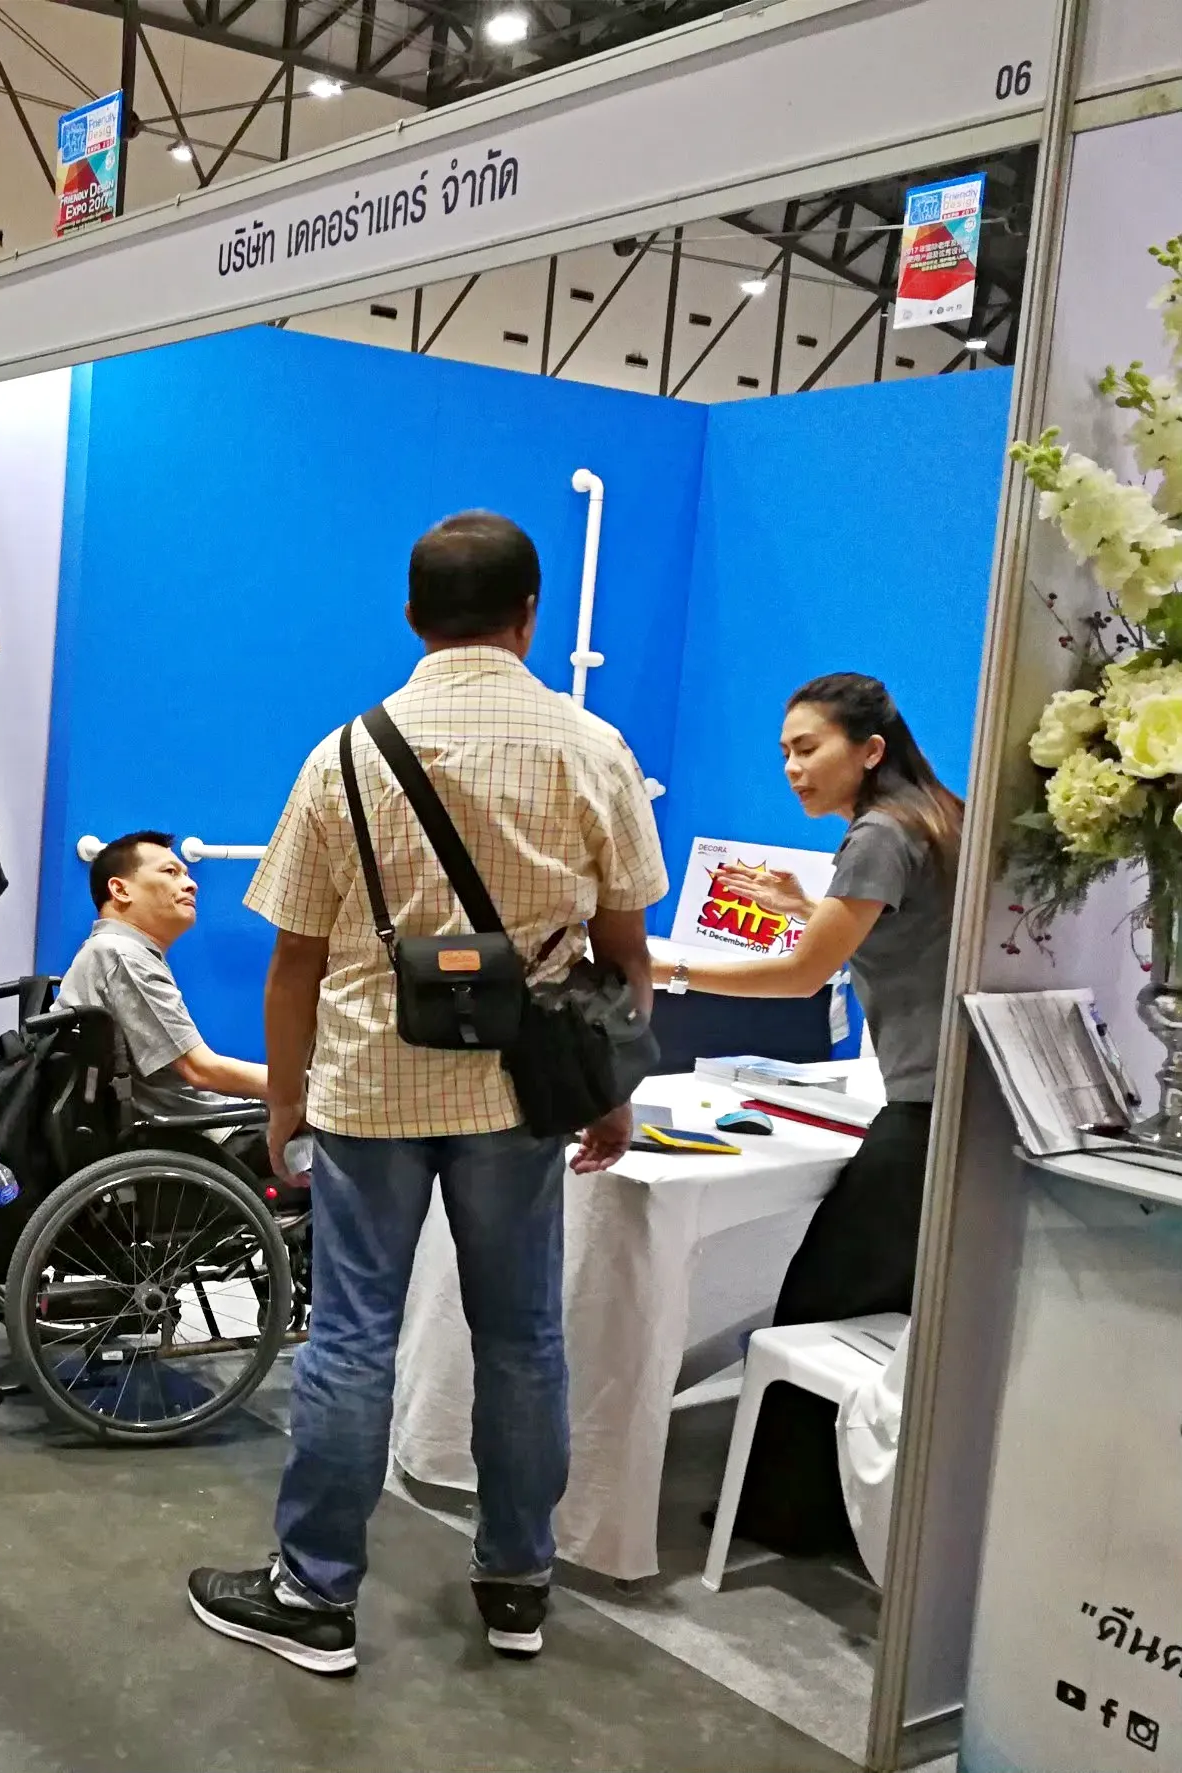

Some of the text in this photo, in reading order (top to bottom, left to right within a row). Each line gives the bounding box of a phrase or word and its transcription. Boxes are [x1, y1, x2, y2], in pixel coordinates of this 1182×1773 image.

[996, 60, 1032, 100] 06
[218, 149, 519, 276] บริษัท เดคอร่าแคร์ จำกัด
[698, 843, 727, 853] DECORA
[697, 900, 781, 946] SALE
[709, 930, 749, 948] December
